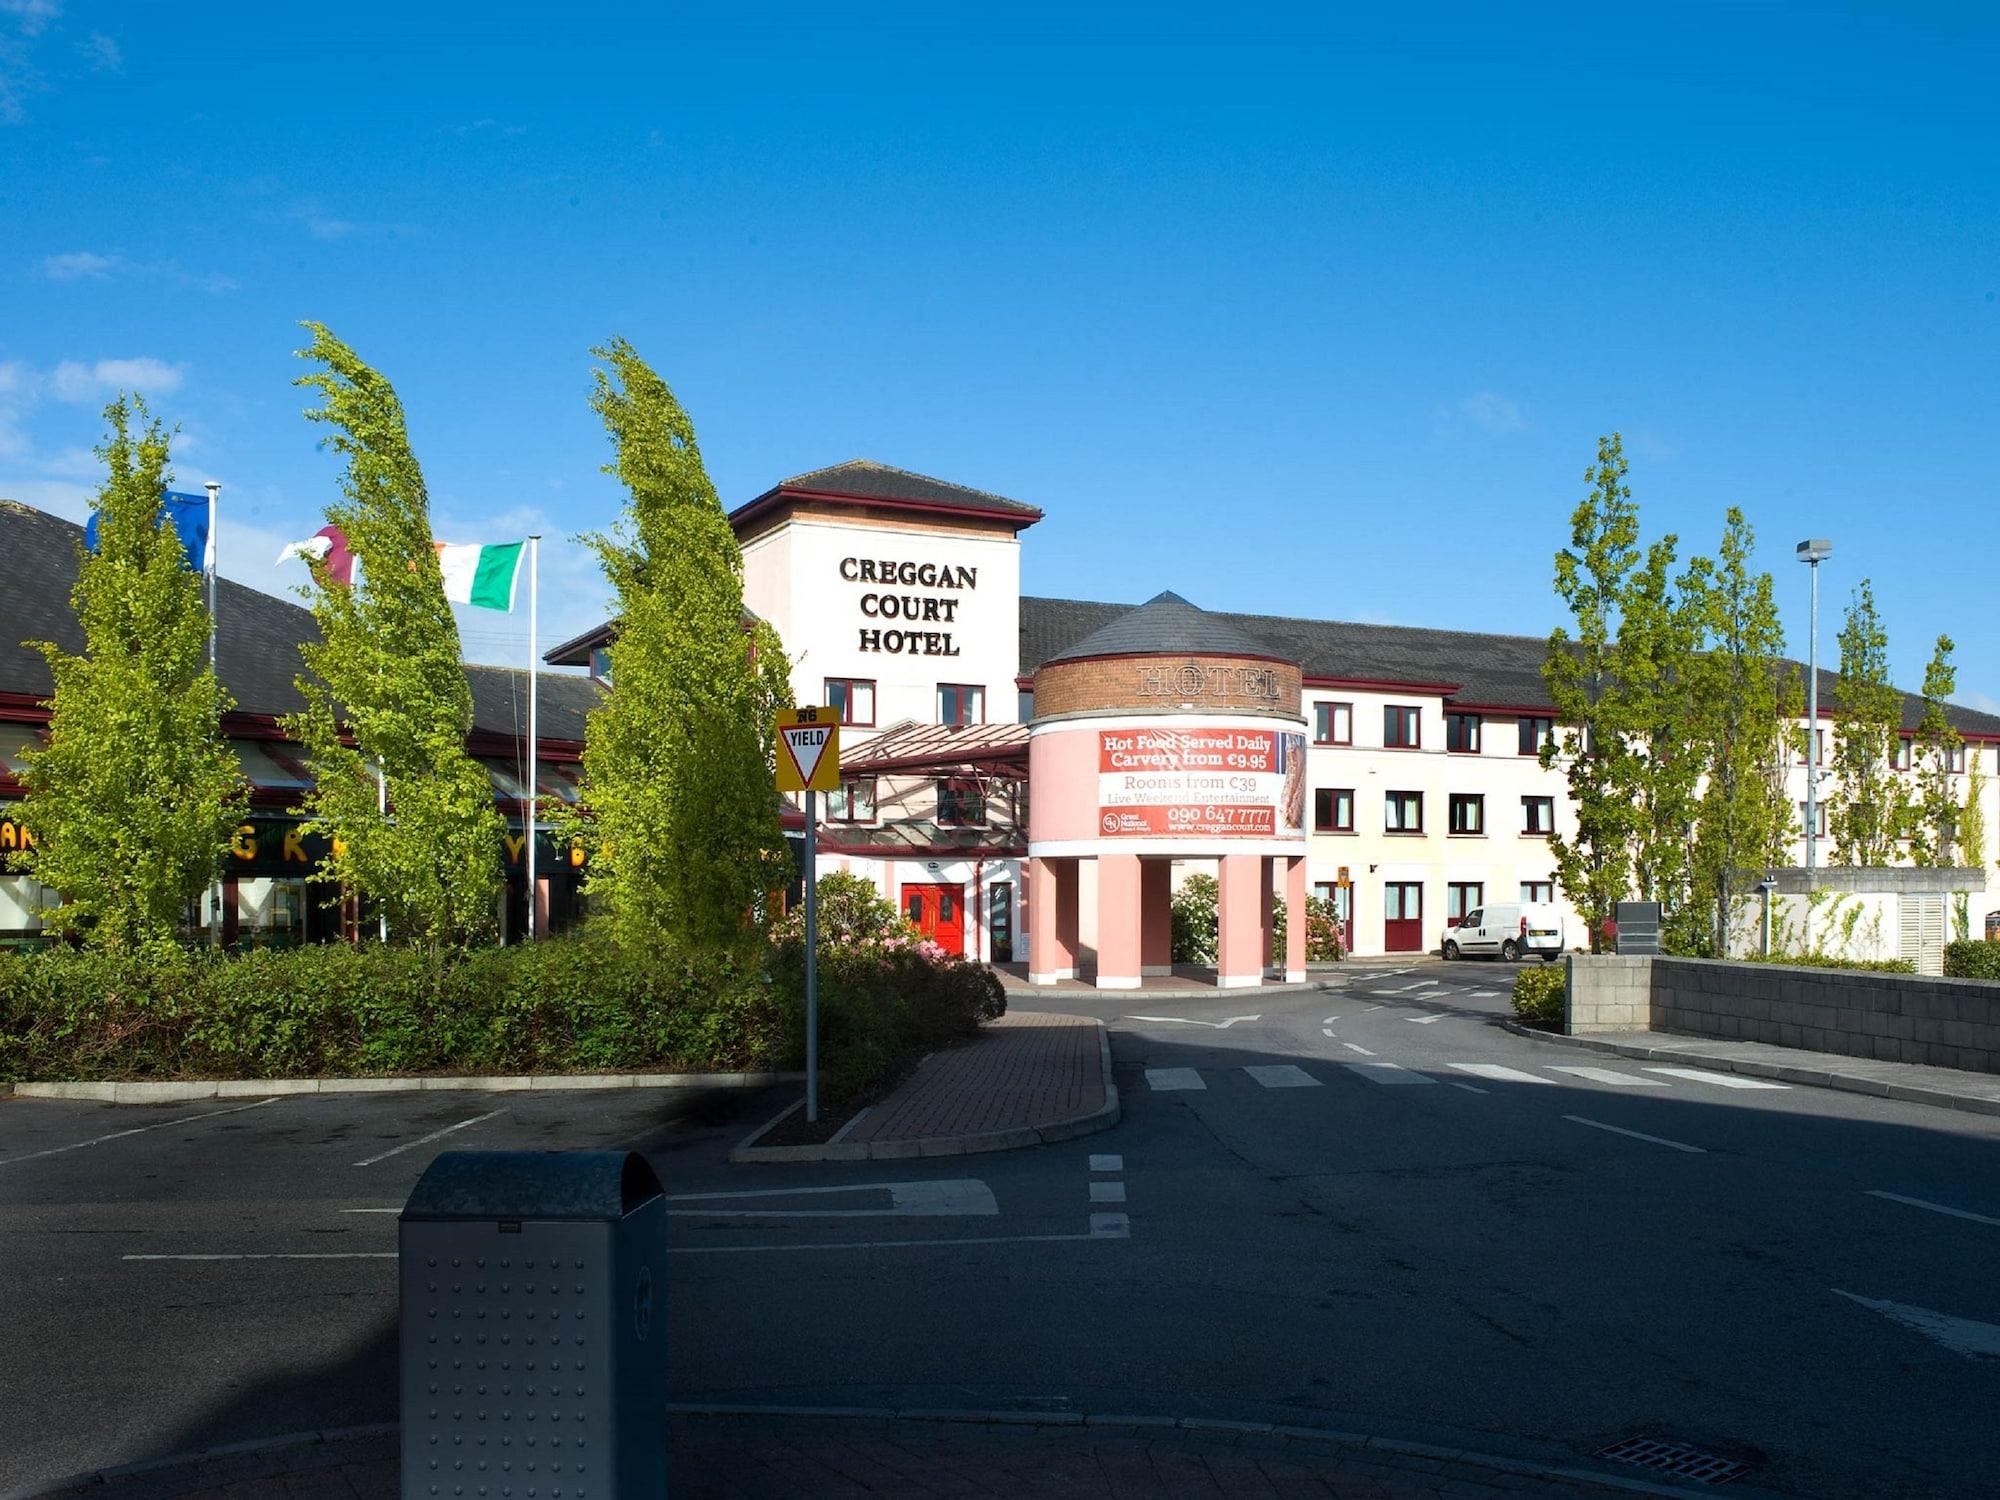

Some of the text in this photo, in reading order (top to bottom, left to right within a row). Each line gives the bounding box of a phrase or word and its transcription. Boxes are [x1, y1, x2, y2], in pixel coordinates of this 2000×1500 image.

[840, 557, 977, 591] CREGGAN
[860, 593, 959, 622] COURT
[859, 628, 960, 656] HOTEL
[1136, 664, 1282, 699] HOTEL
[790, 730, 824, 746] YIELD
[1104, 734, 1272, 754] Hot Food Served Daily
[1111, 749, 1267, 769] Carvery from €9.95
[1125, 775, 1181, 790] Rooms
[1187, 774, 1225, 790] from
[1108, 791, 1270, 804] Live Weekend Entertainment
[1168, 805, 1272, 825] 090 647 7777
